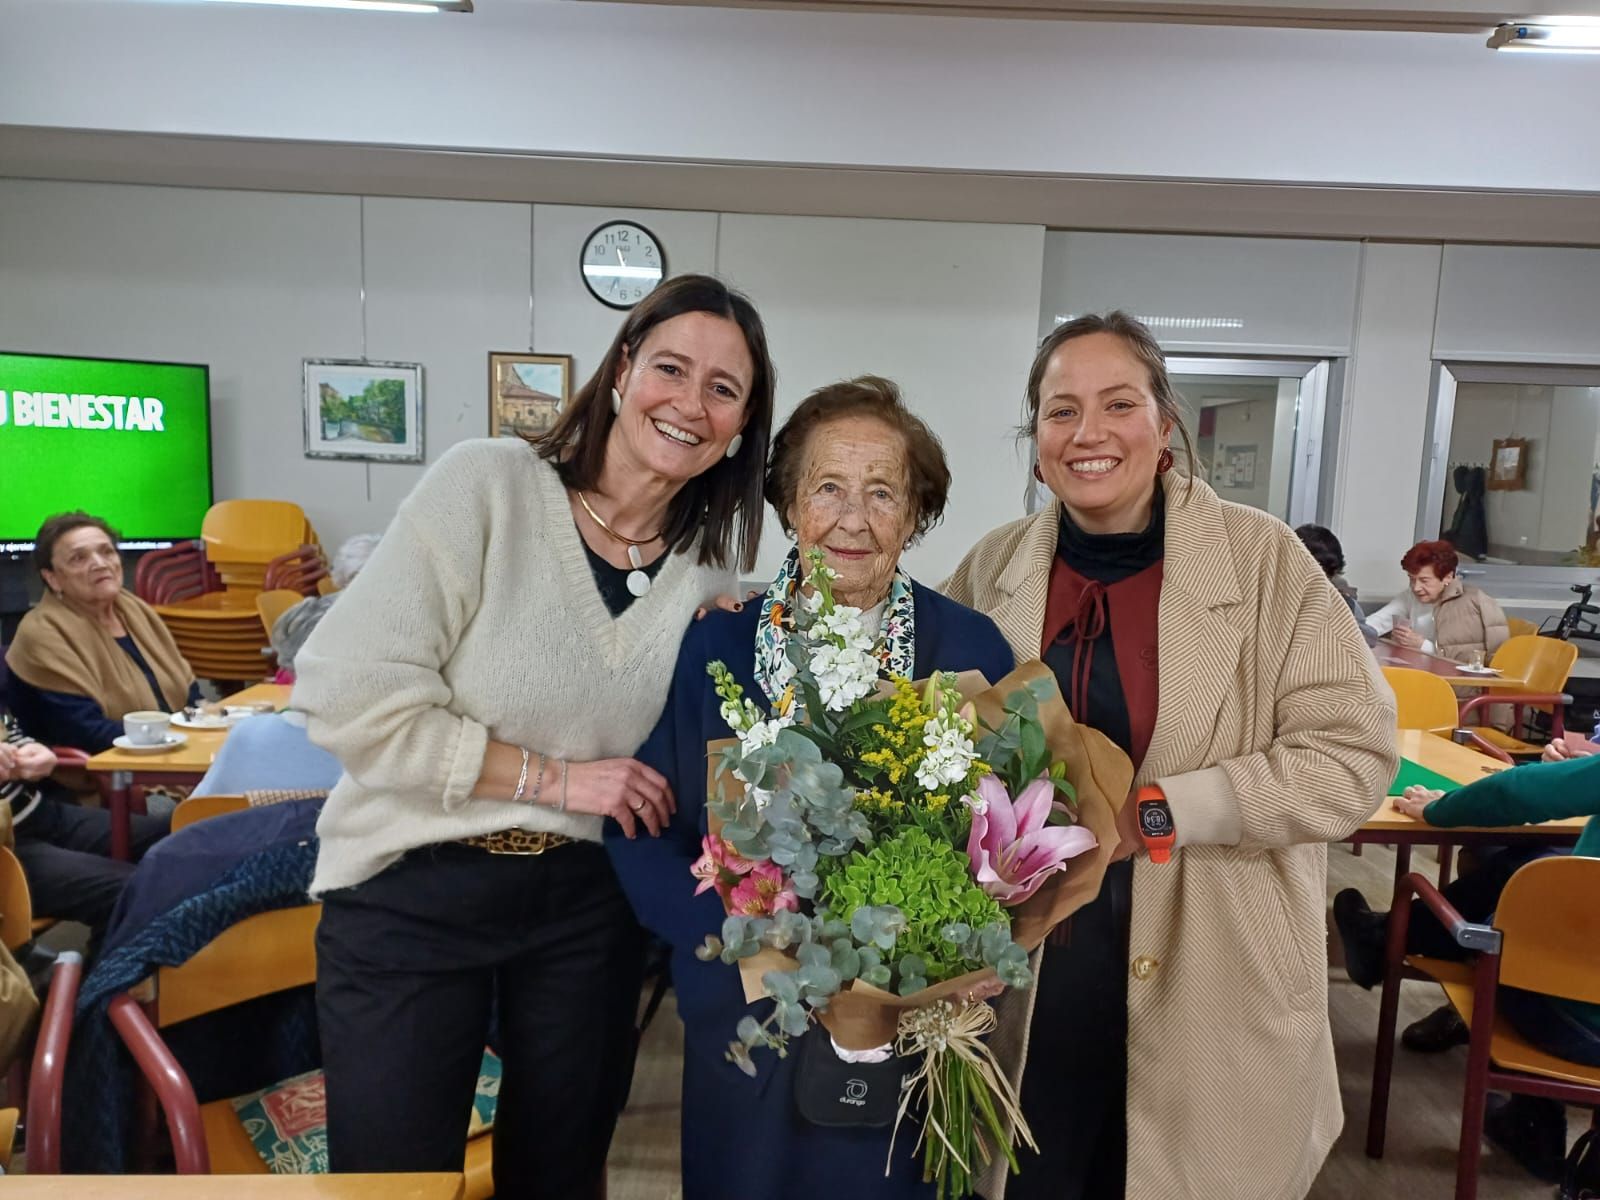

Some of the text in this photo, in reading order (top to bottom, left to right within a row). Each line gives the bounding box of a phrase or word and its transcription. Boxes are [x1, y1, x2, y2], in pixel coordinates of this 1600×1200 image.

[605, 233, 615, 245] 11
[617, 230, 629, 242] 12
[636, 234, 641, 245] 1
[594, 245, 605, 256] 10
[645, 246, 653, 257] 2
[619, 289, 628, 300] 6
[13, 390, 164, 431] BIENESTAR
